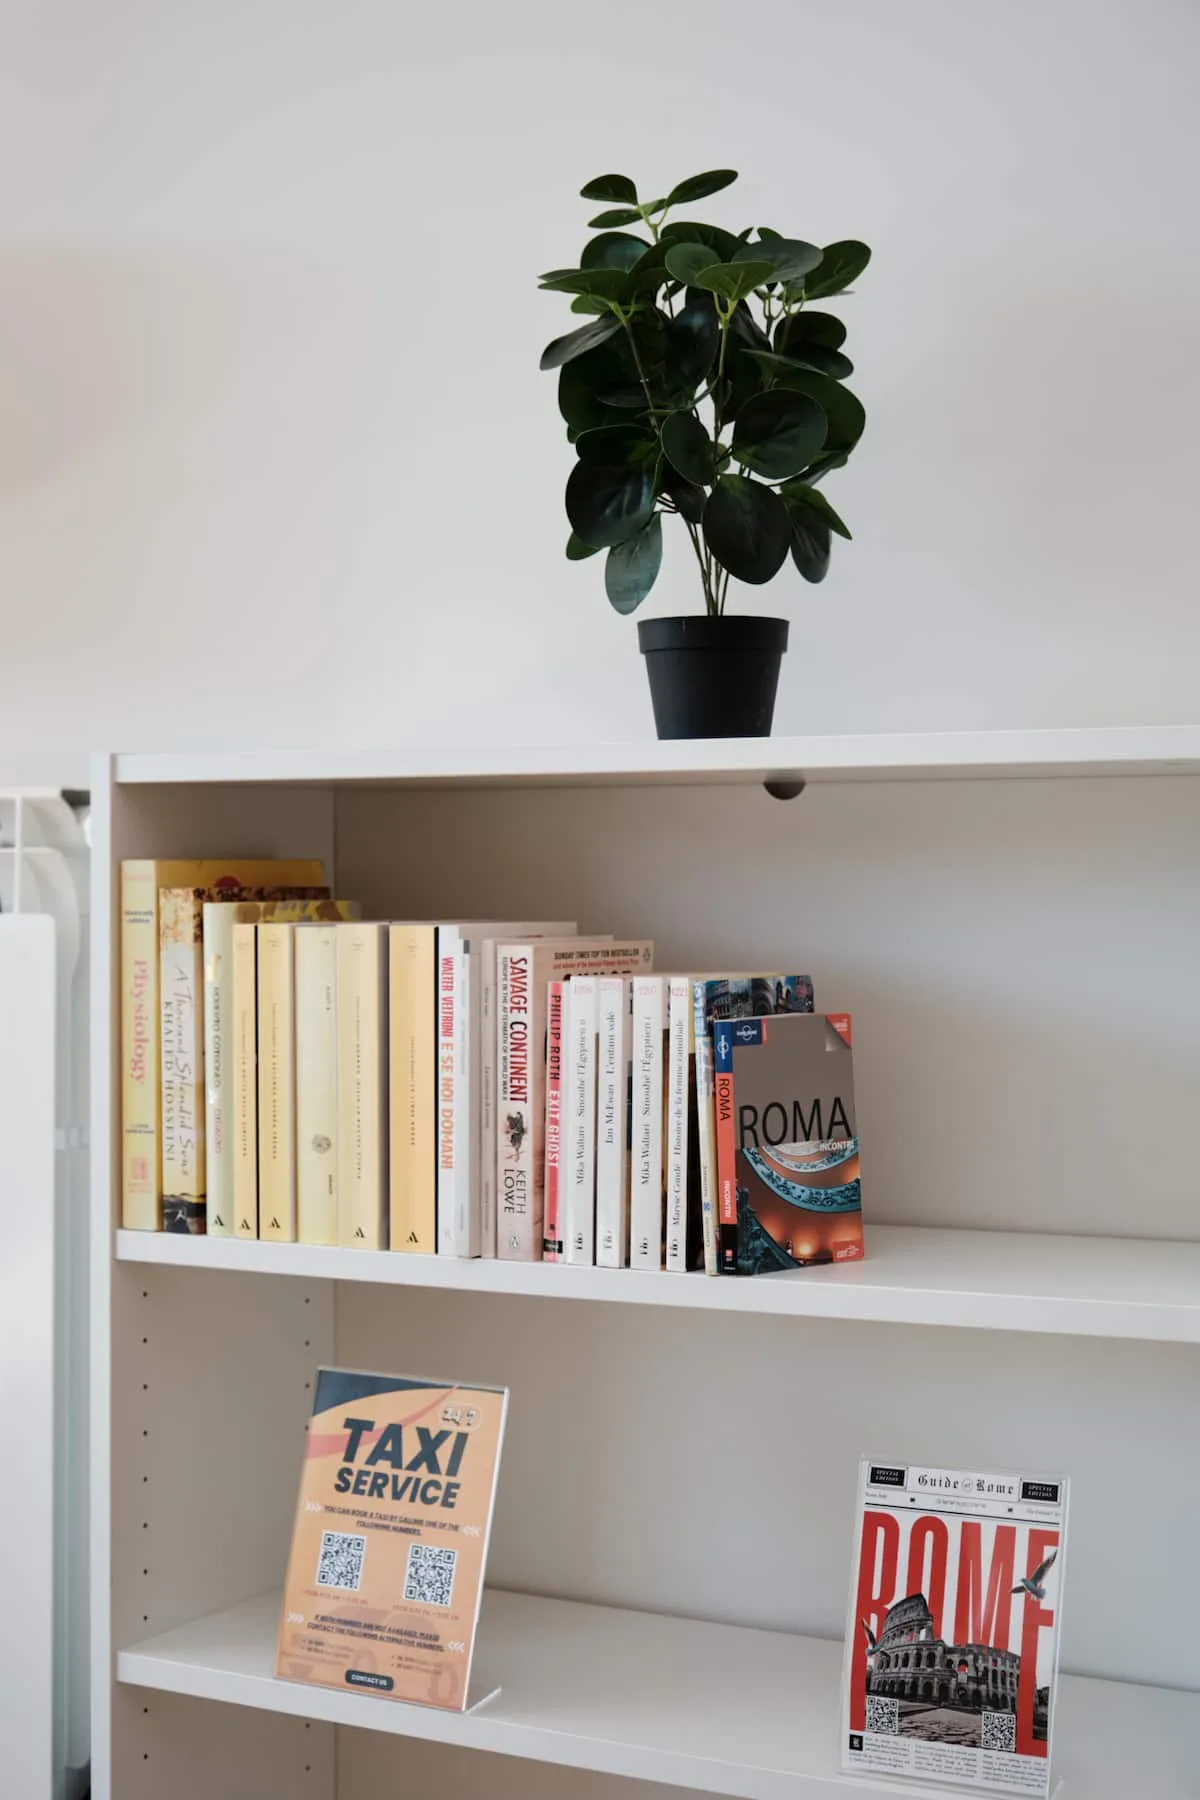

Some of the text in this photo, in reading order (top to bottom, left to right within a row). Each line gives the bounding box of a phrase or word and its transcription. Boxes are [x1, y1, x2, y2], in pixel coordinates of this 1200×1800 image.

[129, 960, 150, 1083] Physiology
[509, 957, 528, 1104] SAVAGE CONTINENT
[440, 956, 454, 1169] WALTER VELTRONI E SE NOI DOMANI
[502, 1045, 509, 1054] OF
[163, 1000, 175, 1162] KHALED HOSSEINI
[547, 994, 561, 1168] PHILIP ROTH EXIT GHOST
[718, 1078, 731, 1121] ROMA
[604, 1084, 615, 1124] McEwan
[738, 1096, 853, 1151] ROMA
[575, 1125, 585, 1159] Waltari
[604, 1128, 614, 1144] Ian
[640, 1124, 651, 1159] Waltari
[504, 1168, 515, 1214] LOWE
[515, 1170, 527, 1214] KEITH
[575, 1161, 585, 1185] Mika
[640, 1161, 650, 1185] Mika
[342, 1417, 470, 1477] TAXI
[333, 1466, 461, 1509] SERVICE
[918, 1474, 959, 1489] Guide
[976, 1478, 1014, 1494] Rome
[849, 1510, 1060, 1758] ROME
[351, 1673, 378, 1685] CONTACT
